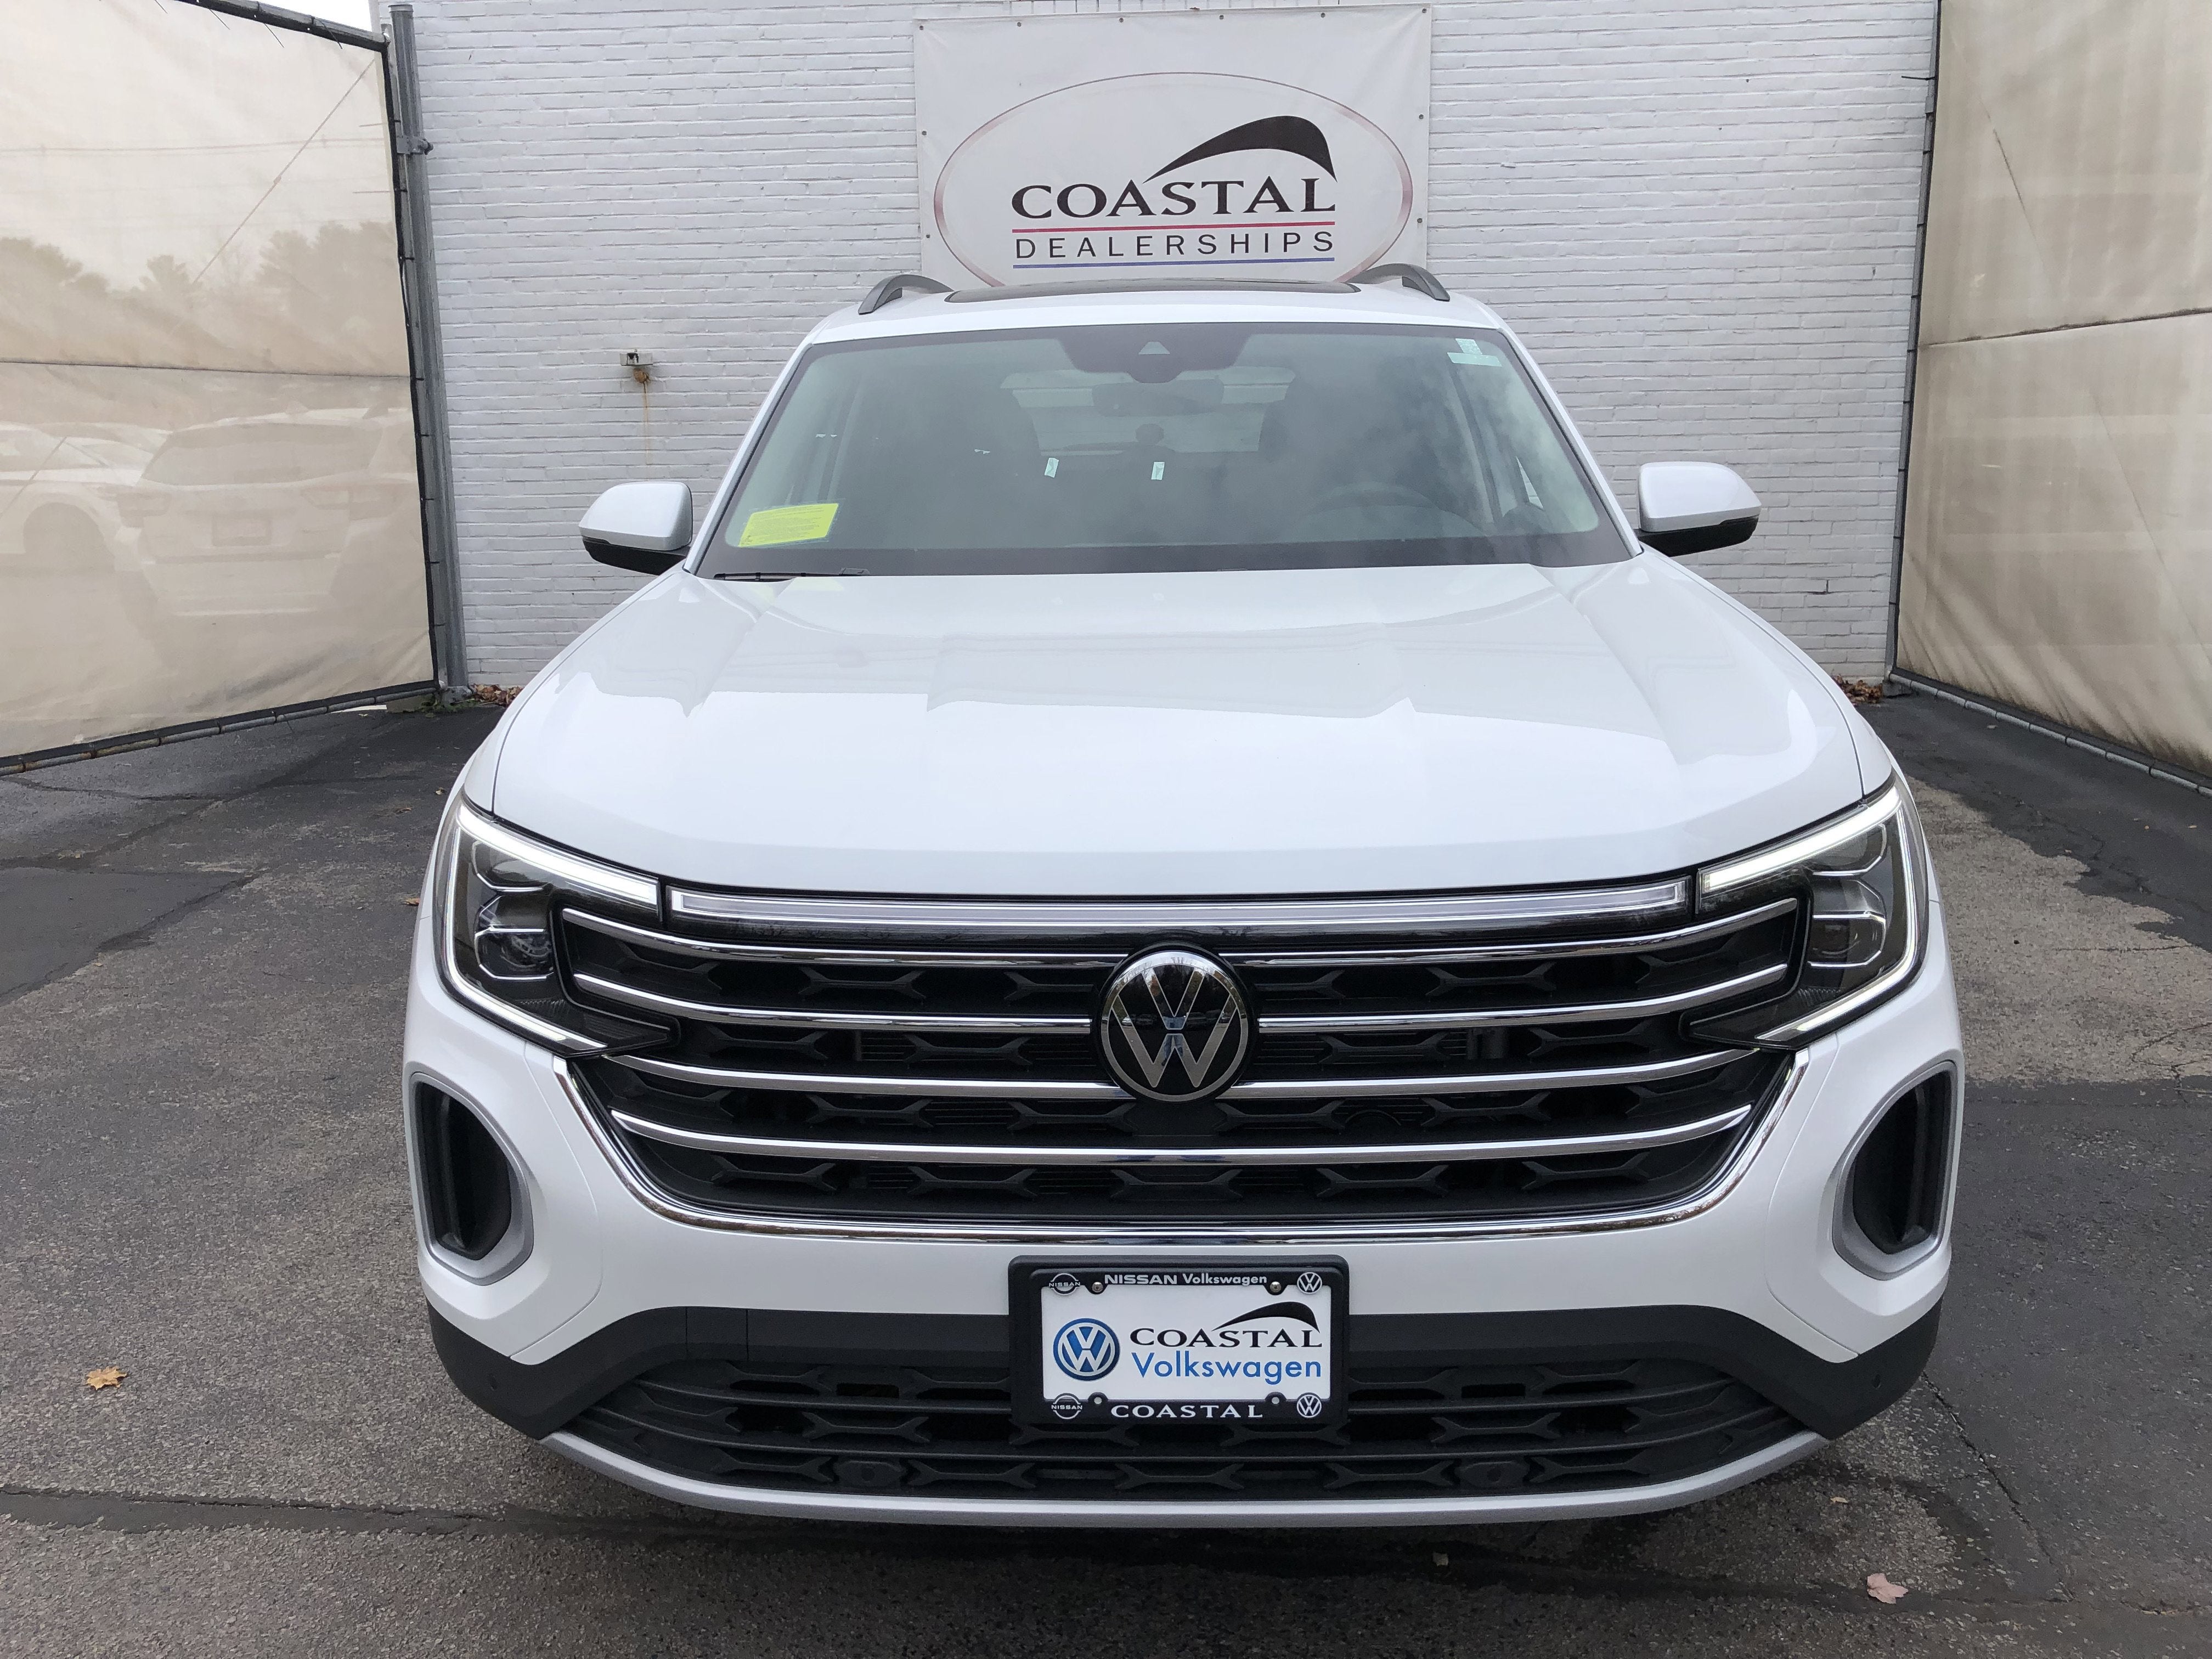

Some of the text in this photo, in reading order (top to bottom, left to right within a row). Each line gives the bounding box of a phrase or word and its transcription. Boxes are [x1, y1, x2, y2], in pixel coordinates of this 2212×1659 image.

[1011, 176, 1335, 219] COASTAL
[1016, 231, 1333, 259] DEALERSHIPS
[1104, 1273, 1267, 1286] NISSAN Volkswagen
[1130, 1328, 1322, 1348] COASTAL
[1131, 1350, 1321, 1385] Volkswagen
[1110, 1404, 1263, 1418] COASTAL
